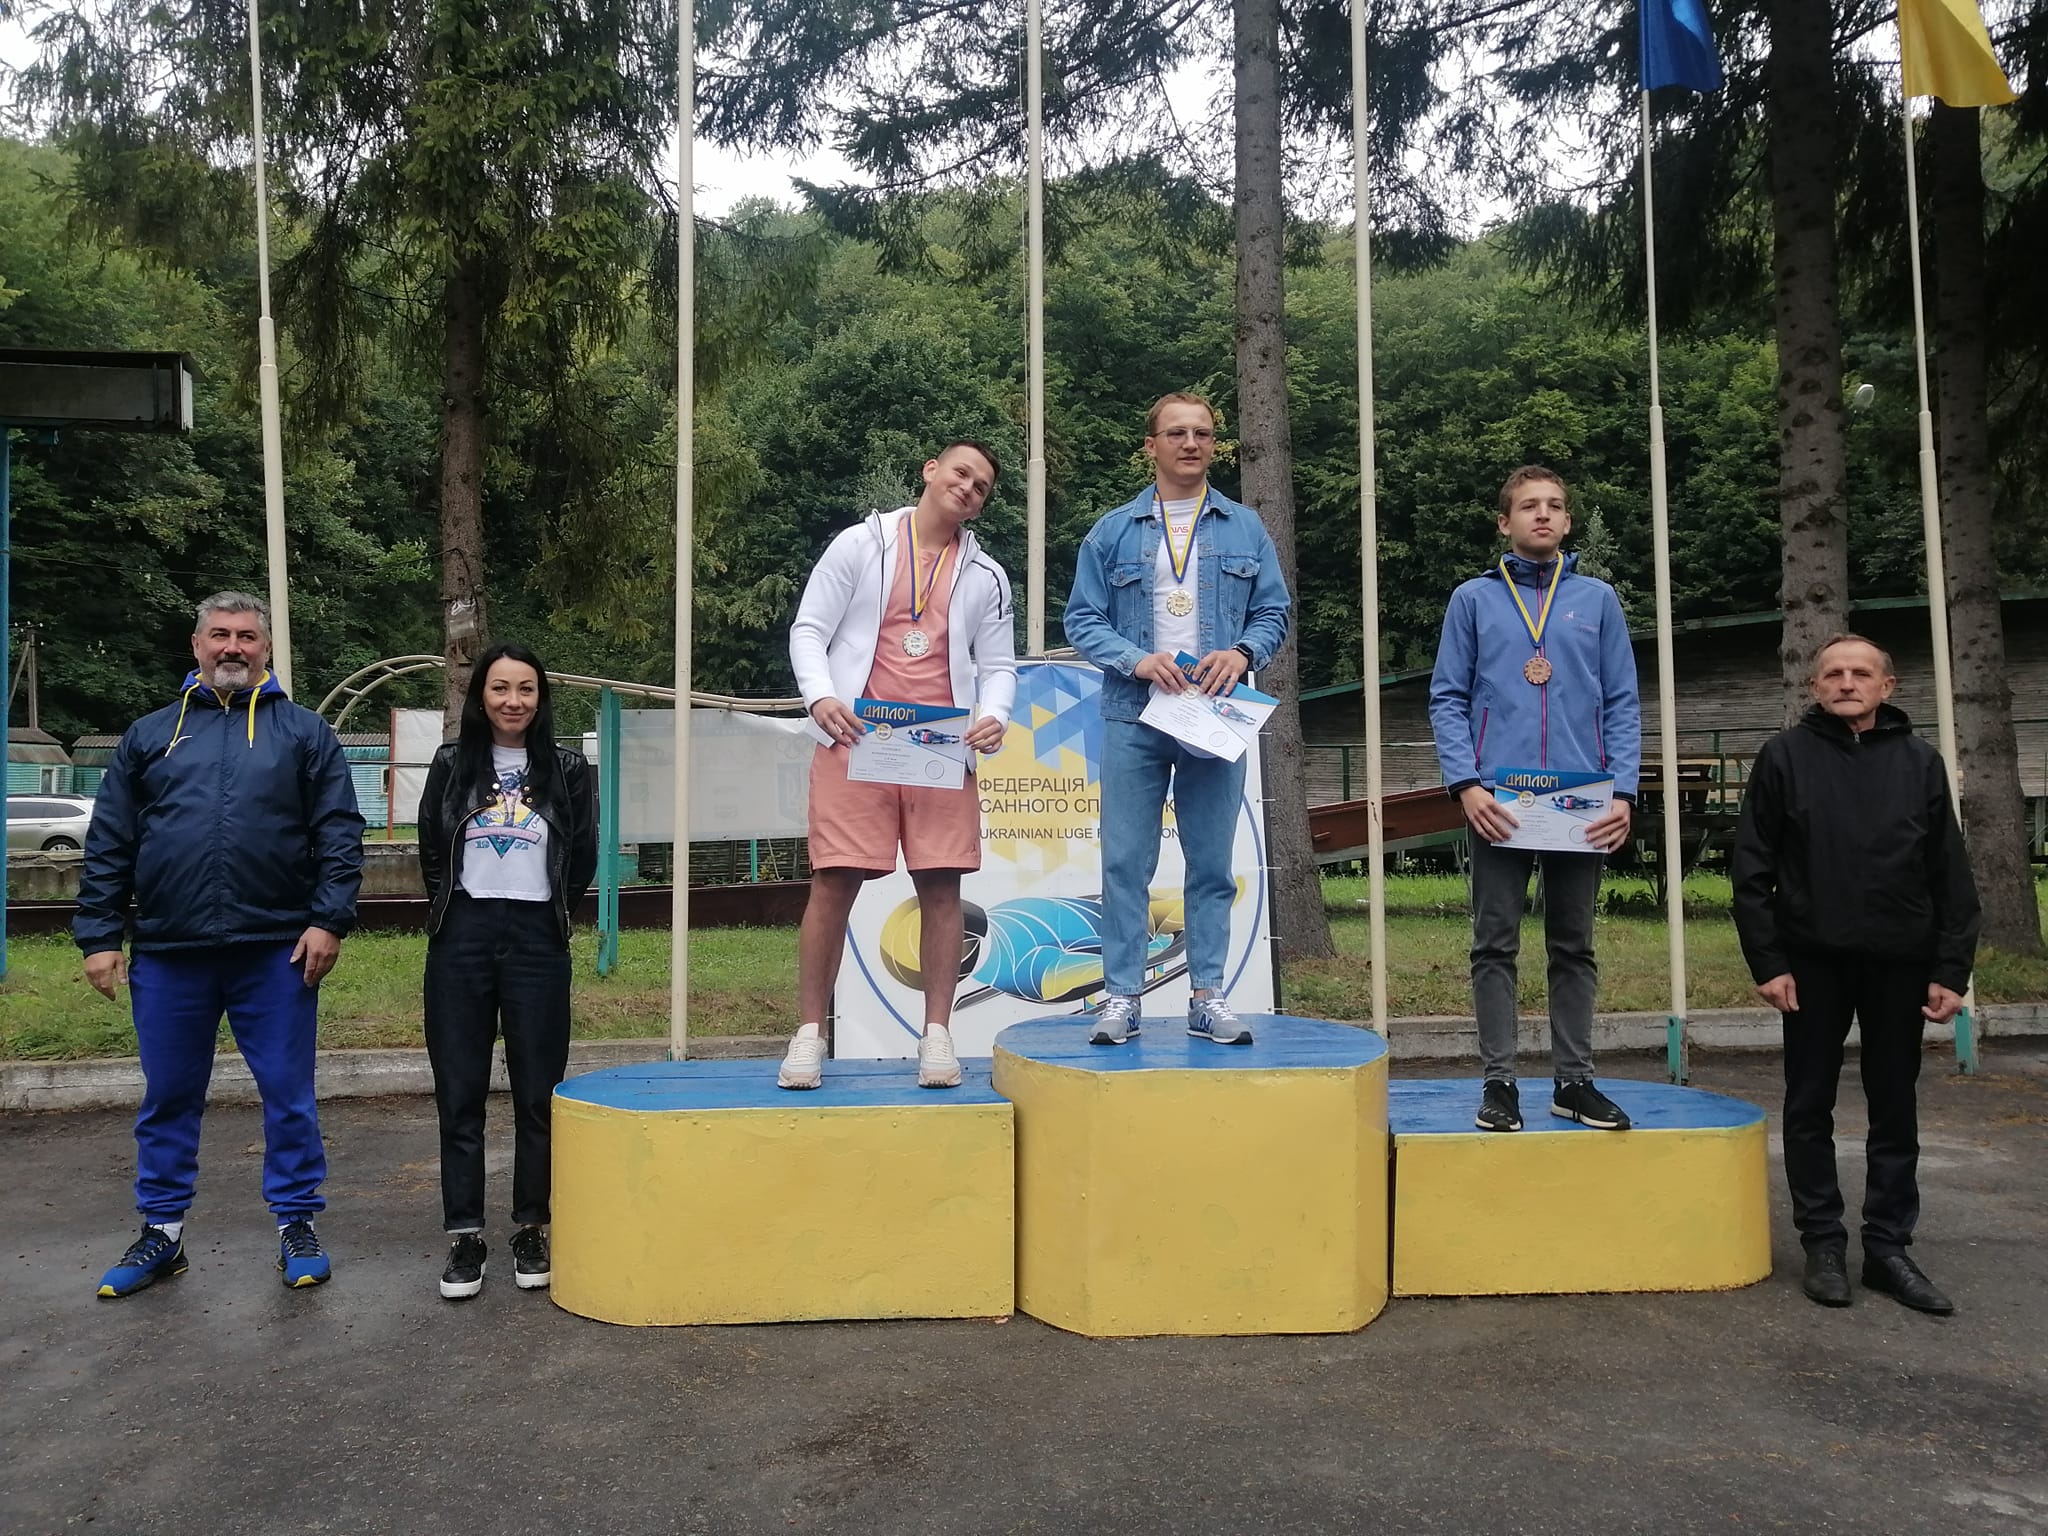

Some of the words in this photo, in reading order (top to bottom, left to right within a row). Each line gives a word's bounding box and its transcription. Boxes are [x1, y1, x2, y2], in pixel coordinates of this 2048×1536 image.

[863, 704, 916, 721] ДИПЛОМ
[979, 777, 1084, 795] ФЕДЕРАЦІЯ
[1505, 773, 1559, 788] ДИПЛОМ
[979, 799, 1068, 813] САННОГО
[980, 827, 1053, 839] UKRAINIAN
[1057, 827, 1093, 839] LUGE
